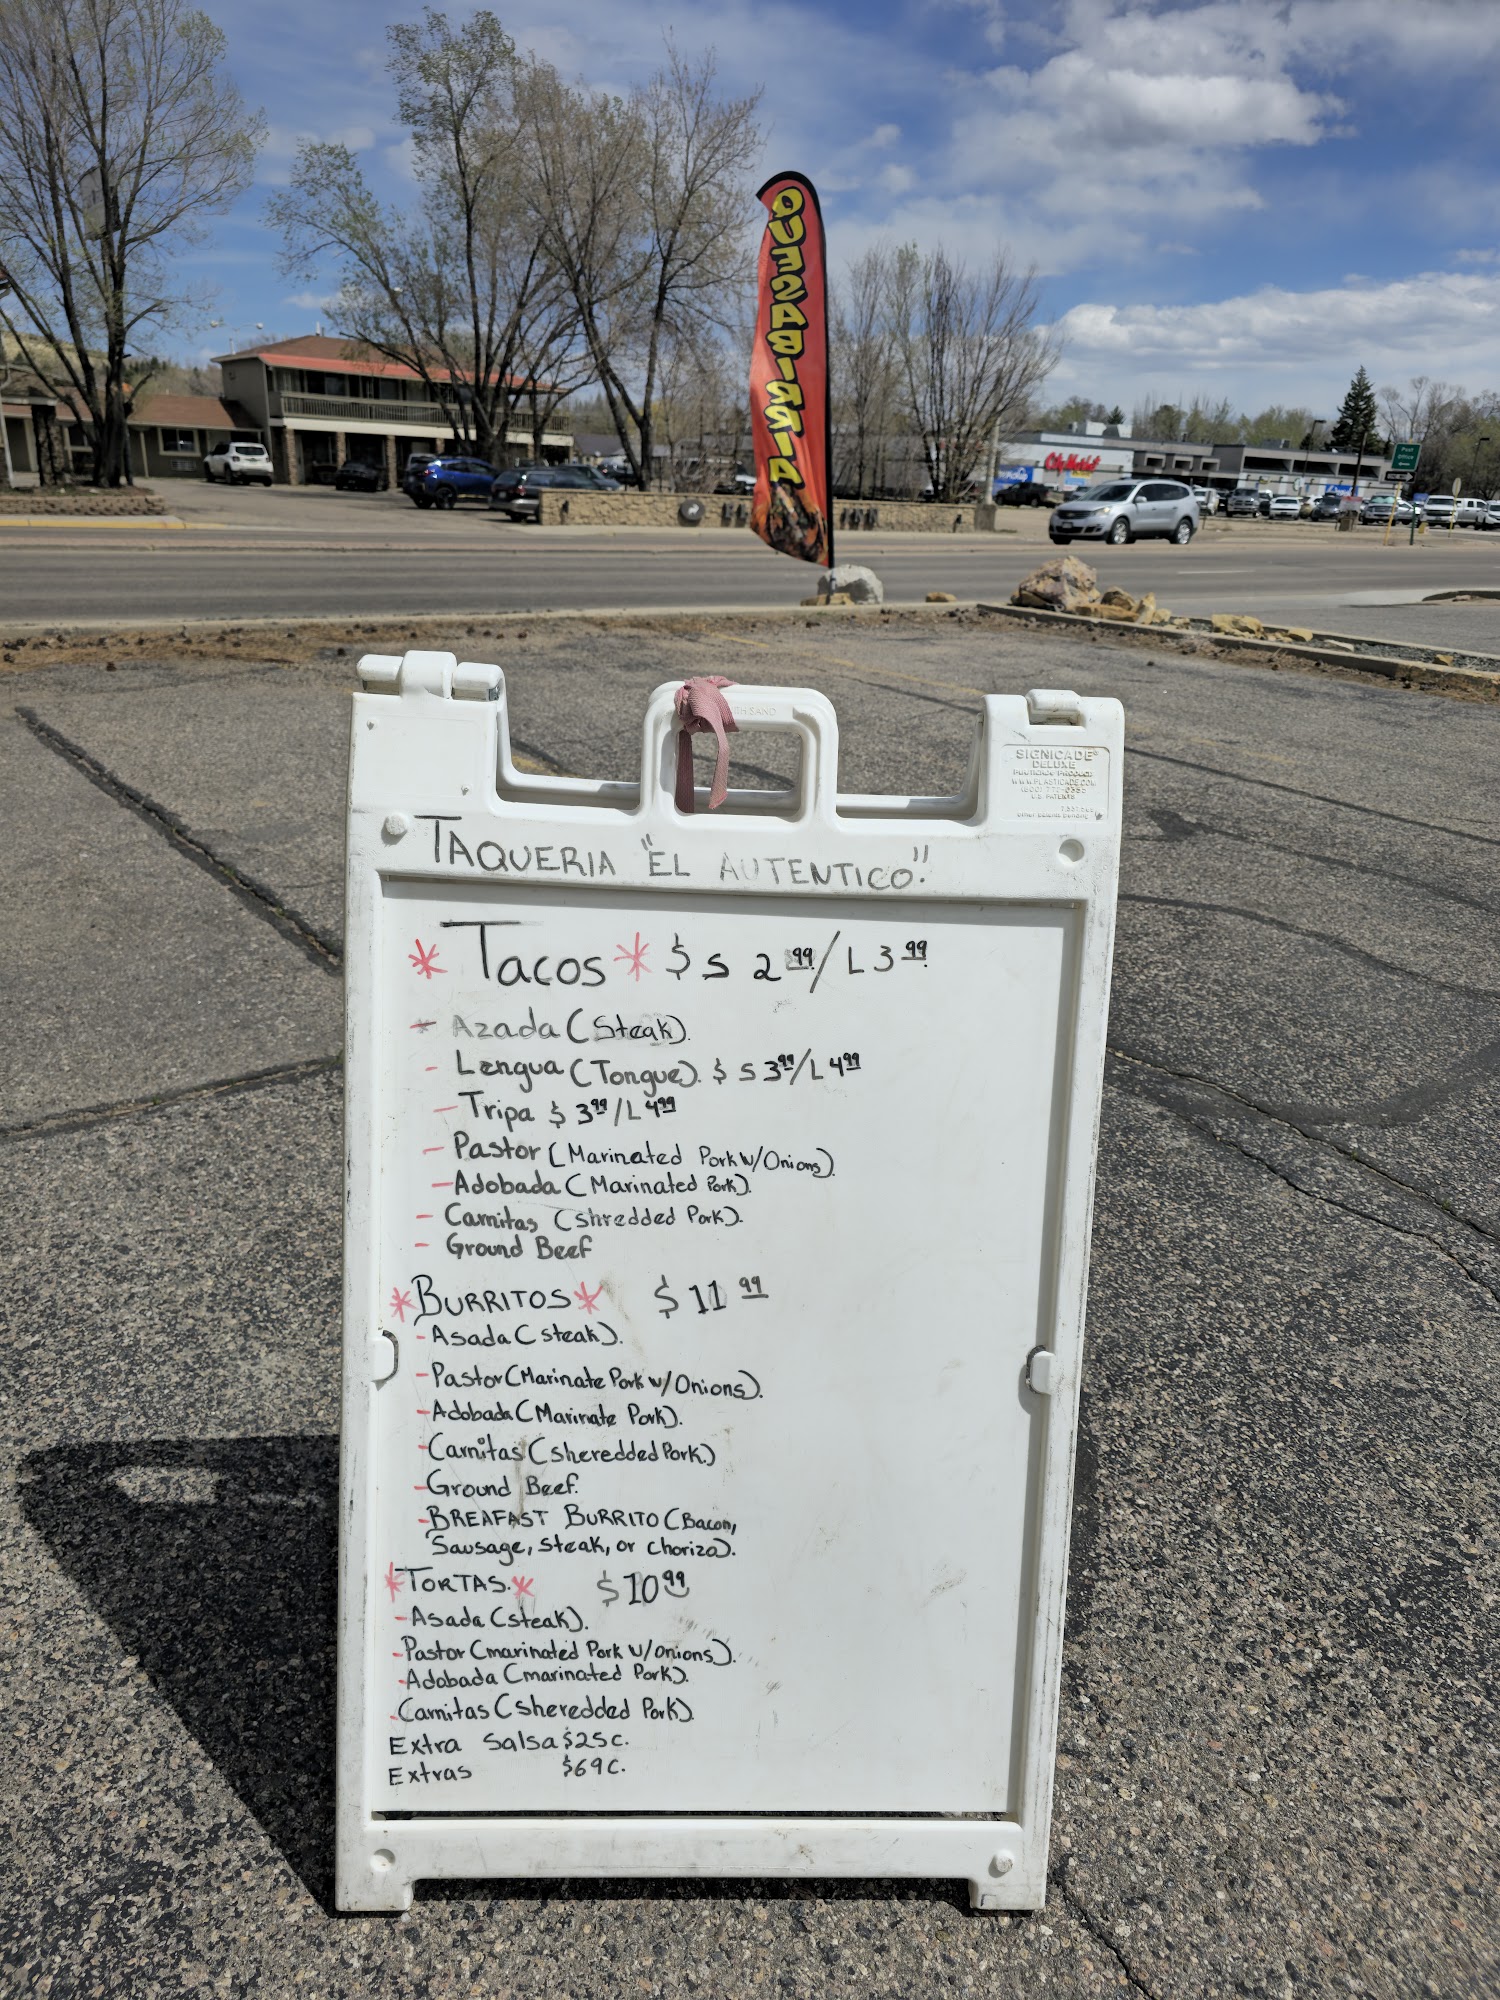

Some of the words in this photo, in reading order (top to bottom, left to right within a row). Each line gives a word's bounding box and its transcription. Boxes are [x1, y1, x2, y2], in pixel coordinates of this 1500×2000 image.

[1032, 760, 1076, 769] DELUXE
[414, 815, 617, 877] TAQUERIA
[440, 921, 606, 986] Tacos
[456, 1049, 564, 1093] Lengua
[458, 1090, 535, 1133] Tripa
[453, 1130, 541, 1160] Pastor
[699, 1146, 737, 1168] Pork
[454, 1169, 561, 1195] Adobada
[444, 1202, 539, 1233] Carnitas
[446, 1232, 523, 1259] Ground
[535, 1235, 593, 1260] Beef
[411, 1274, 572, 1326] BURRITOS
[432, 1324, 511, 1346] Asada
[431, 1362, 502, 1388] Pastor
[609, 1367, 644, 1390] Pork
[433, 1399, 513, 1422] Adobada
[428, 1432, 524, 1462] Carnitas
[426, 1469, 511, 1497] Ground
[425, 1505, 548, 1538] BREAFAST
[564, 1503, 659, 1529] BURRITO
[616, 1540, 635, 1553] or
[412, 1605, 485, 1628] Asada
[400, 1636, 465, 1661] Pastor
[586, 1640, 623, 1660] Pork
[406, 1667, 498, 1690] Adobada
[397, 1696, 490, 1722] Carnitas
[389, 1733, 462, 1755] Extra
[483, 1730, 558, 1752] Salsa
[388, 1761, 472, 1786] Extras
